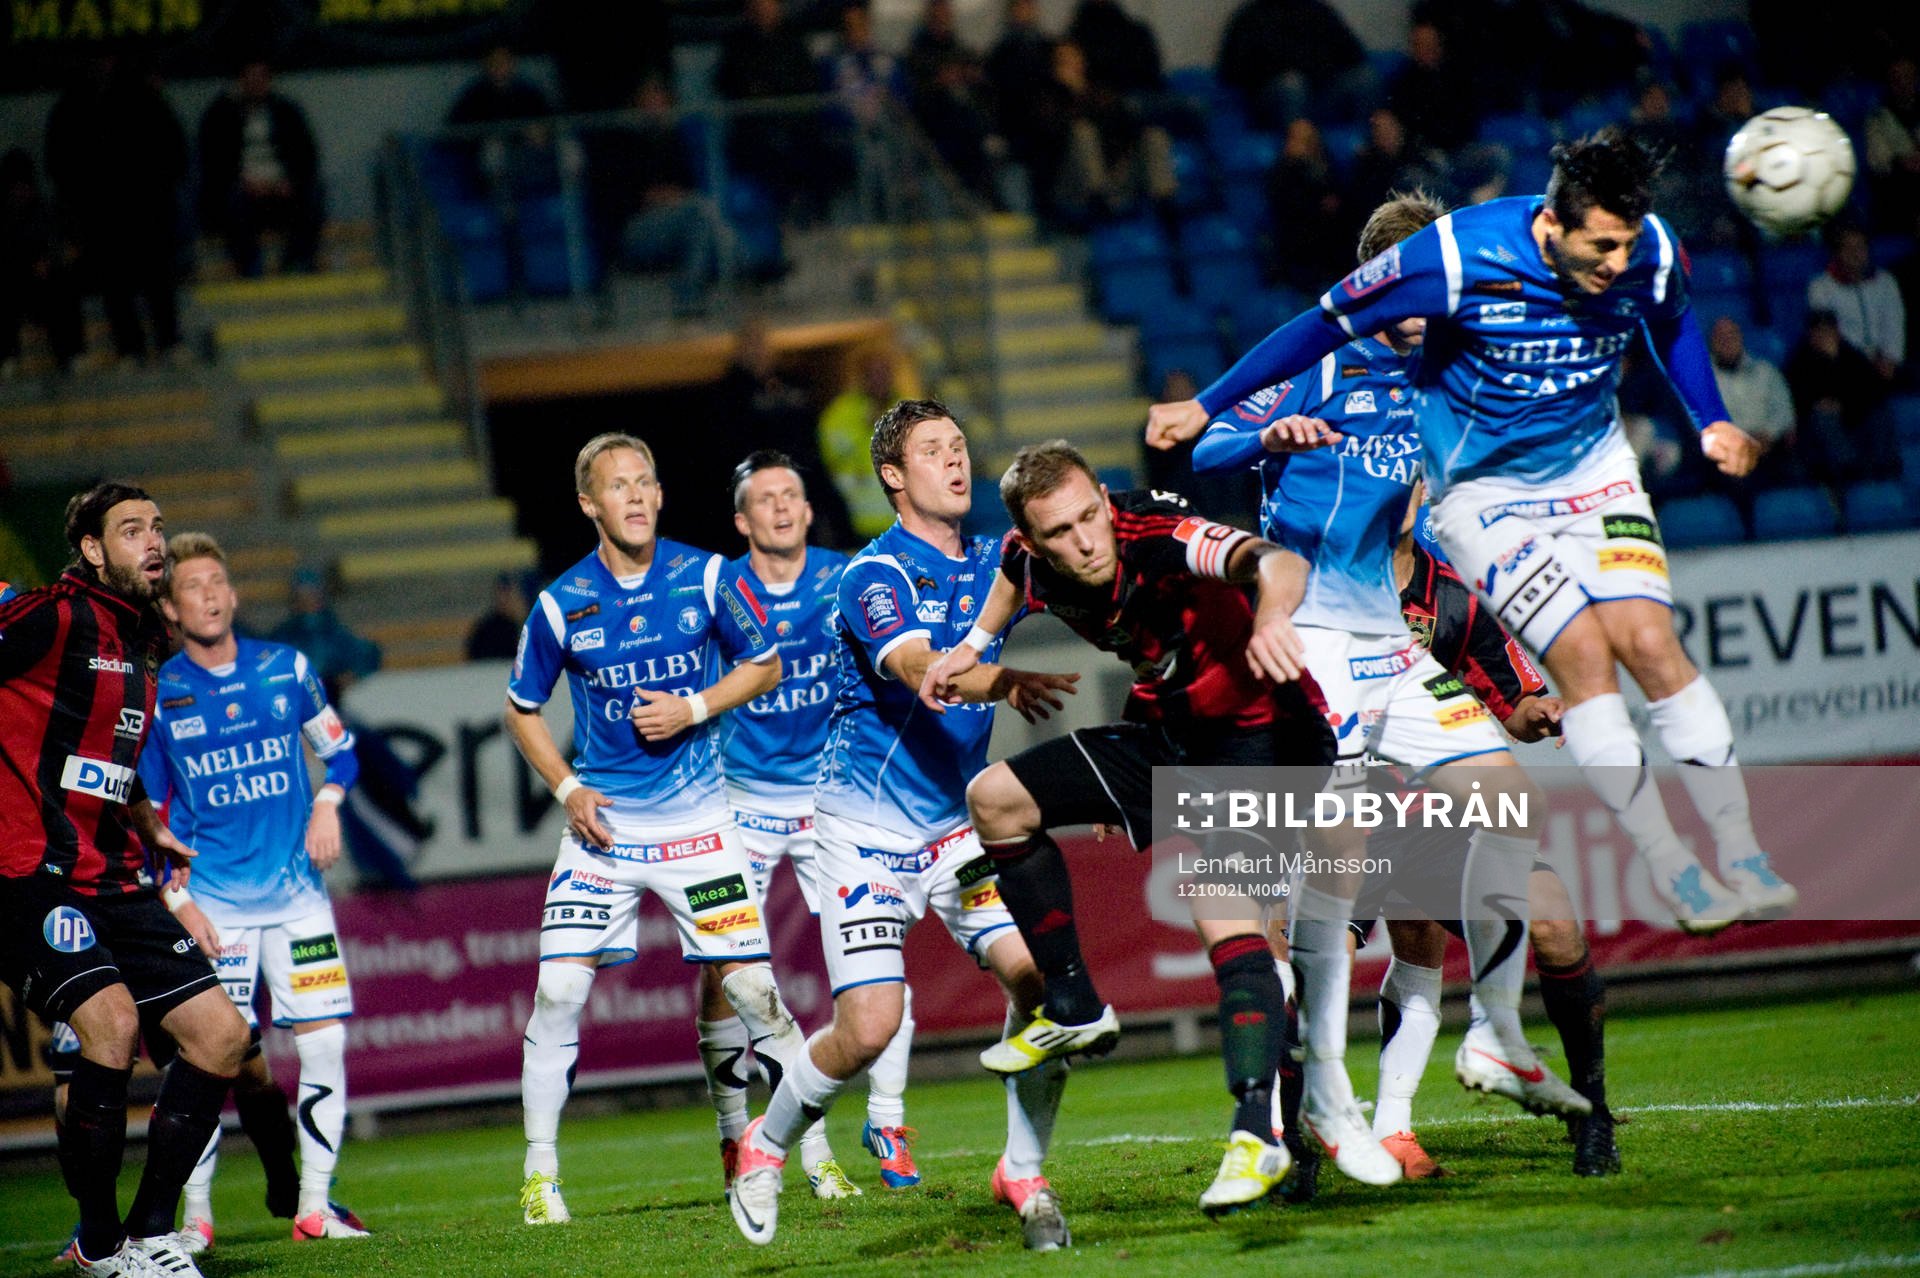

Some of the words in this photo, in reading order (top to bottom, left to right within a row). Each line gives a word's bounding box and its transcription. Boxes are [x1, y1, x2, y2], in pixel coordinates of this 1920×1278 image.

[88, 656, 133, 674] stadium
[588, 646, 704, 689] MELLBY
[1351, 657, 1406, 678] POWER
[748, 681, 830, 713] GÅRD
[184, 734, 291, 779] MELLBY
[207, 772, 289, 808] GÅRD
[737, 812, 799, 833] POWER
[667, 836, 716, 858] HEAT
[572, 870, 614, 887] INTER
[688, 885, 729, 906] akea
[53, 906, 89, 952] hp
[700, 911, 753, 931] DHL
[292, 945, 326, 959] akea
